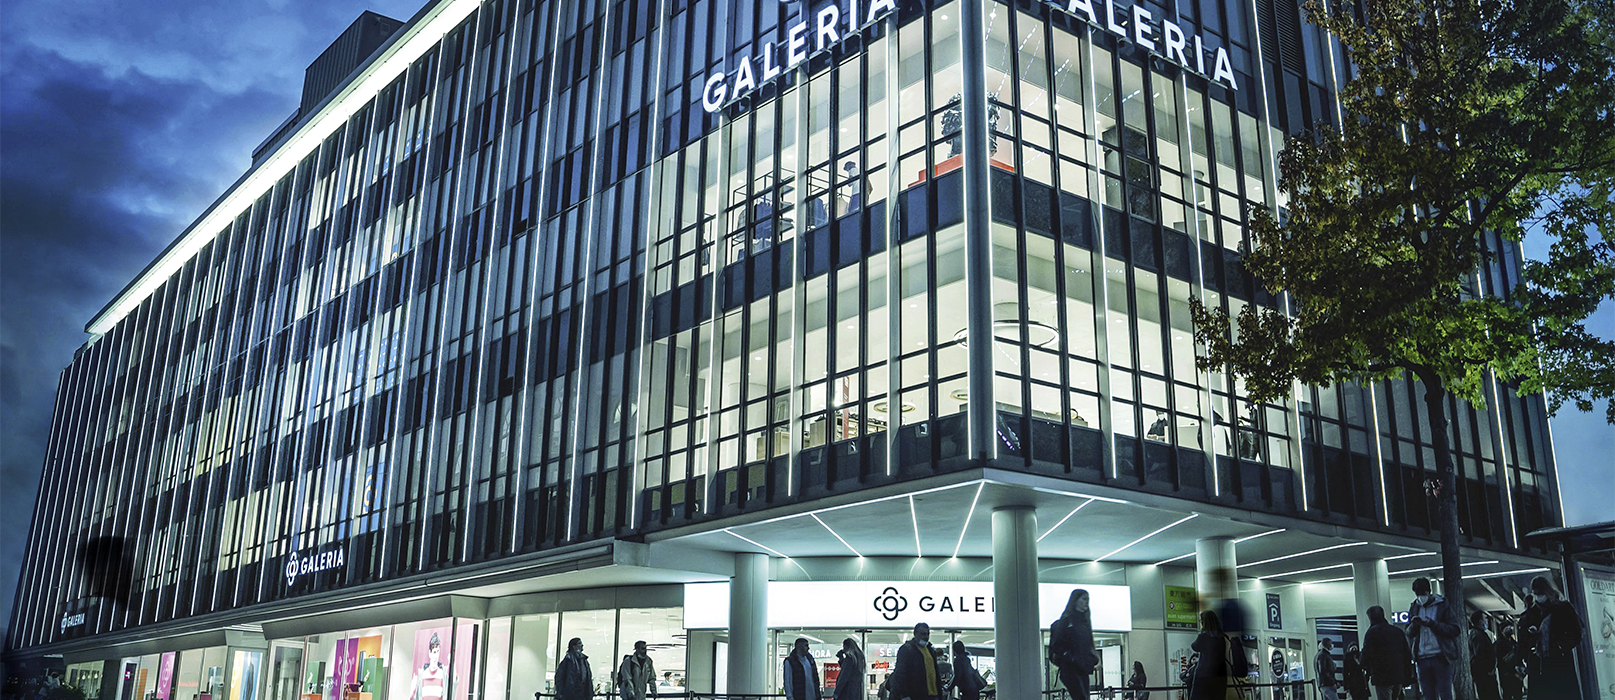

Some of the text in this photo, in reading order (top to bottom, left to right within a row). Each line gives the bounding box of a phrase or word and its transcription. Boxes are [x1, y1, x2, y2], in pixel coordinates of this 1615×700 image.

[702, 0, 896, 113] GALERIA
[1067, 0, 1239, 91] ALERIA
[301, 548, 344, 575] GALERIA
[919, 596, 994, 613] GALE
[67, 613, 85, 627] GALERIA
